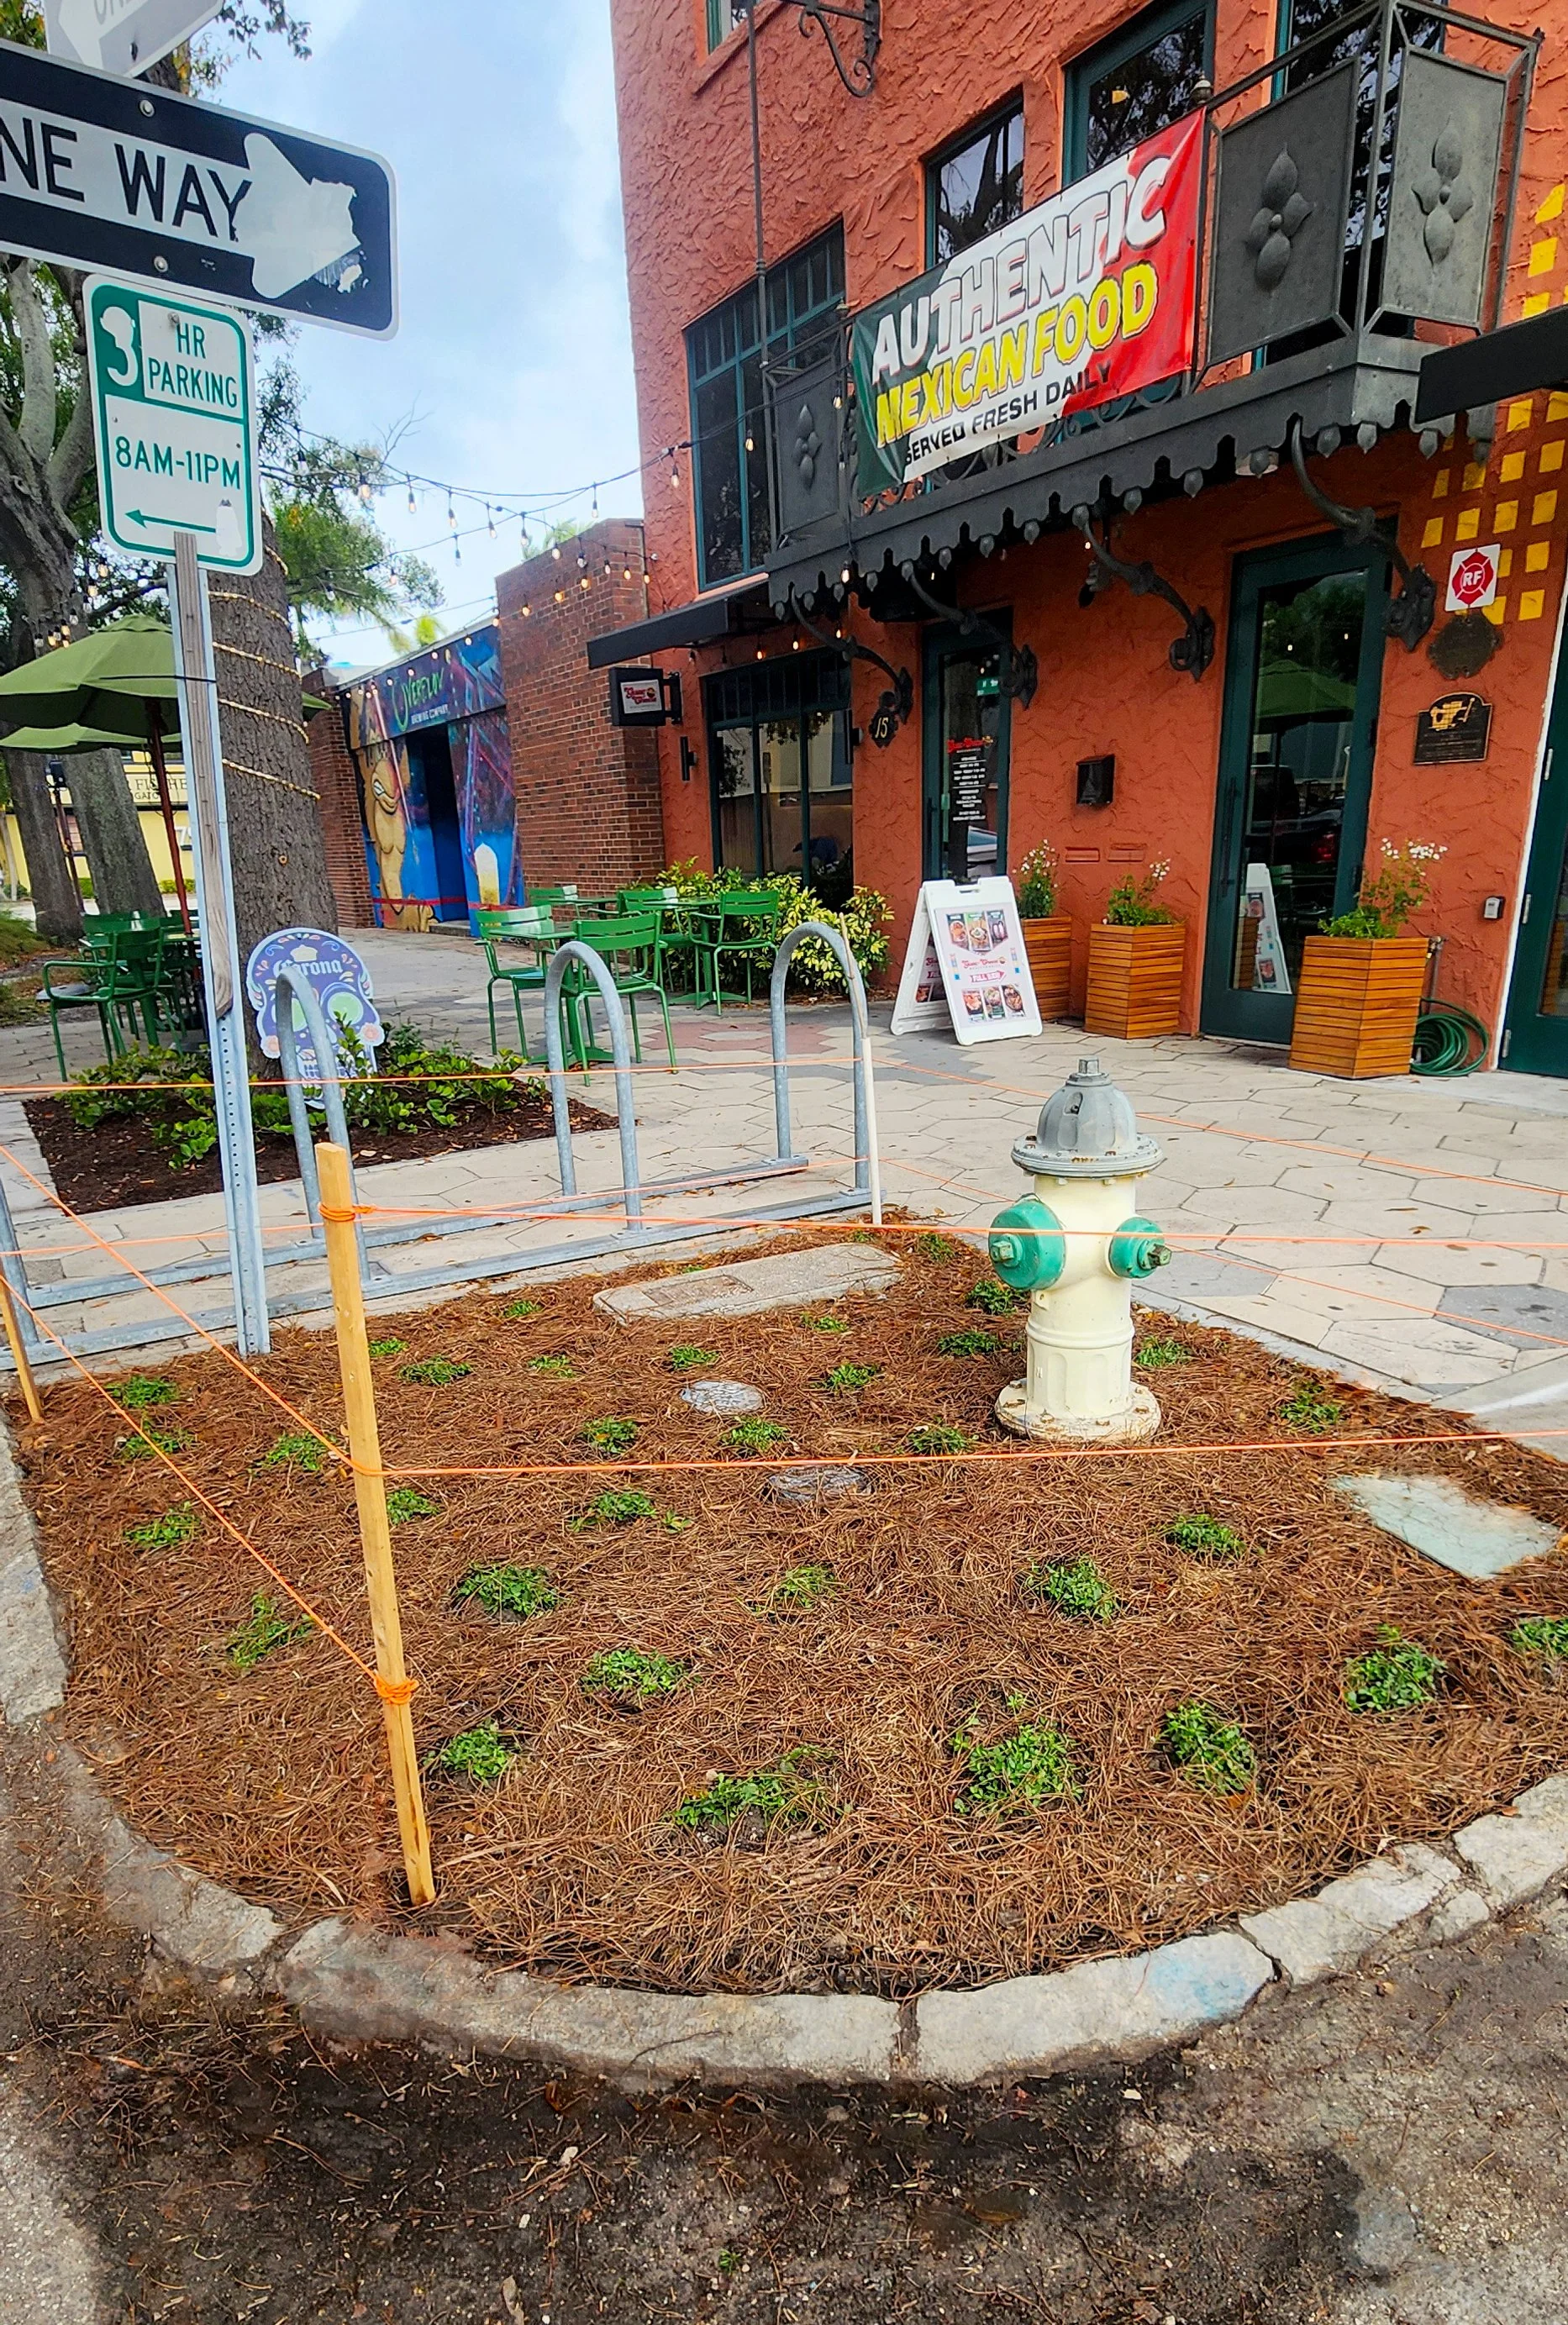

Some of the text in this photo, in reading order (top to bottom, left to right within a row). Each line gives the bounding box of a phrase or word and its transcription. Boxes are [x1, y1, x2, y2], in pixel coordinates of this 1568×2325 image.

[0, 117, 252, 242] NE WAY
[871, 155, 1171, 386] AUTHENTIC
[100, 306, 139, 387] 3
[176, 322, 207, 359] HR
[876, 260, 1159, 448] MEXICAN FOOD
[148, 357, 237, 408] PARKING
[905, 363, 1112, 466] SERVED FRESH DAILY
[115, 435, 241, 490] 8AM-11PM
[1461, 569, 1483, 587] RF
[875, 717, 889, 739] 15
[273, 959, 344, 978] Crona
